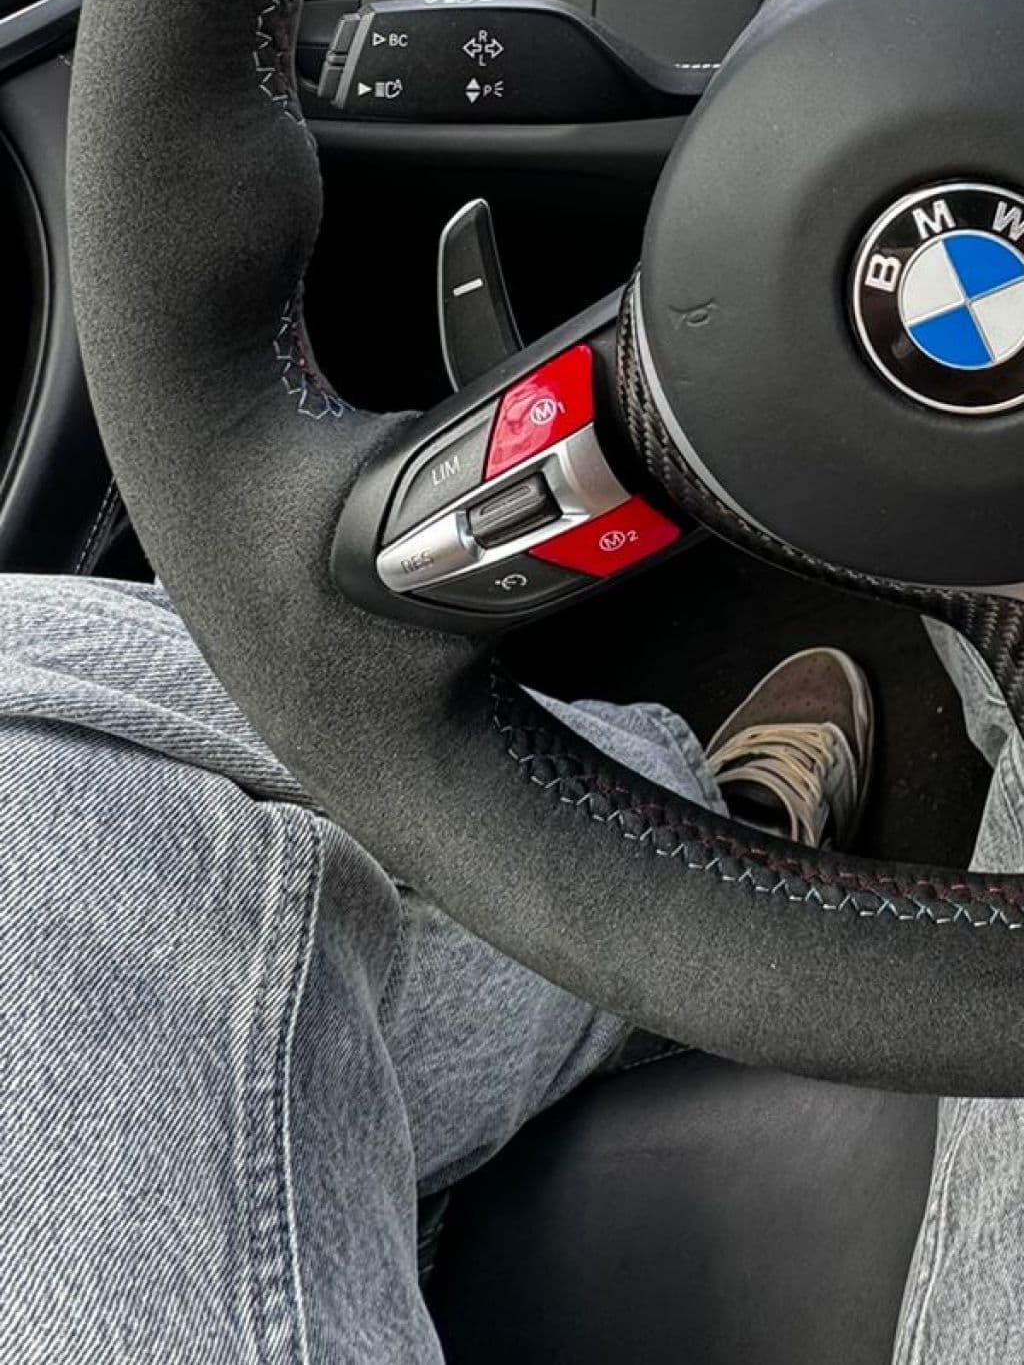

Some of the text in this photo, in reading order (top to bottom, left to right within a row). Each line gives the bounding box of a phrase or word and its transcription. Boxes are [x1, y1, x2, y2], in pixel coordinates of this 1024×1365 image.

[389, 33, 408, 47] BC
[479, 29, 488, 42] R
[478, 55, 487, 67] L
[431, 455, 461, 485] LIM
